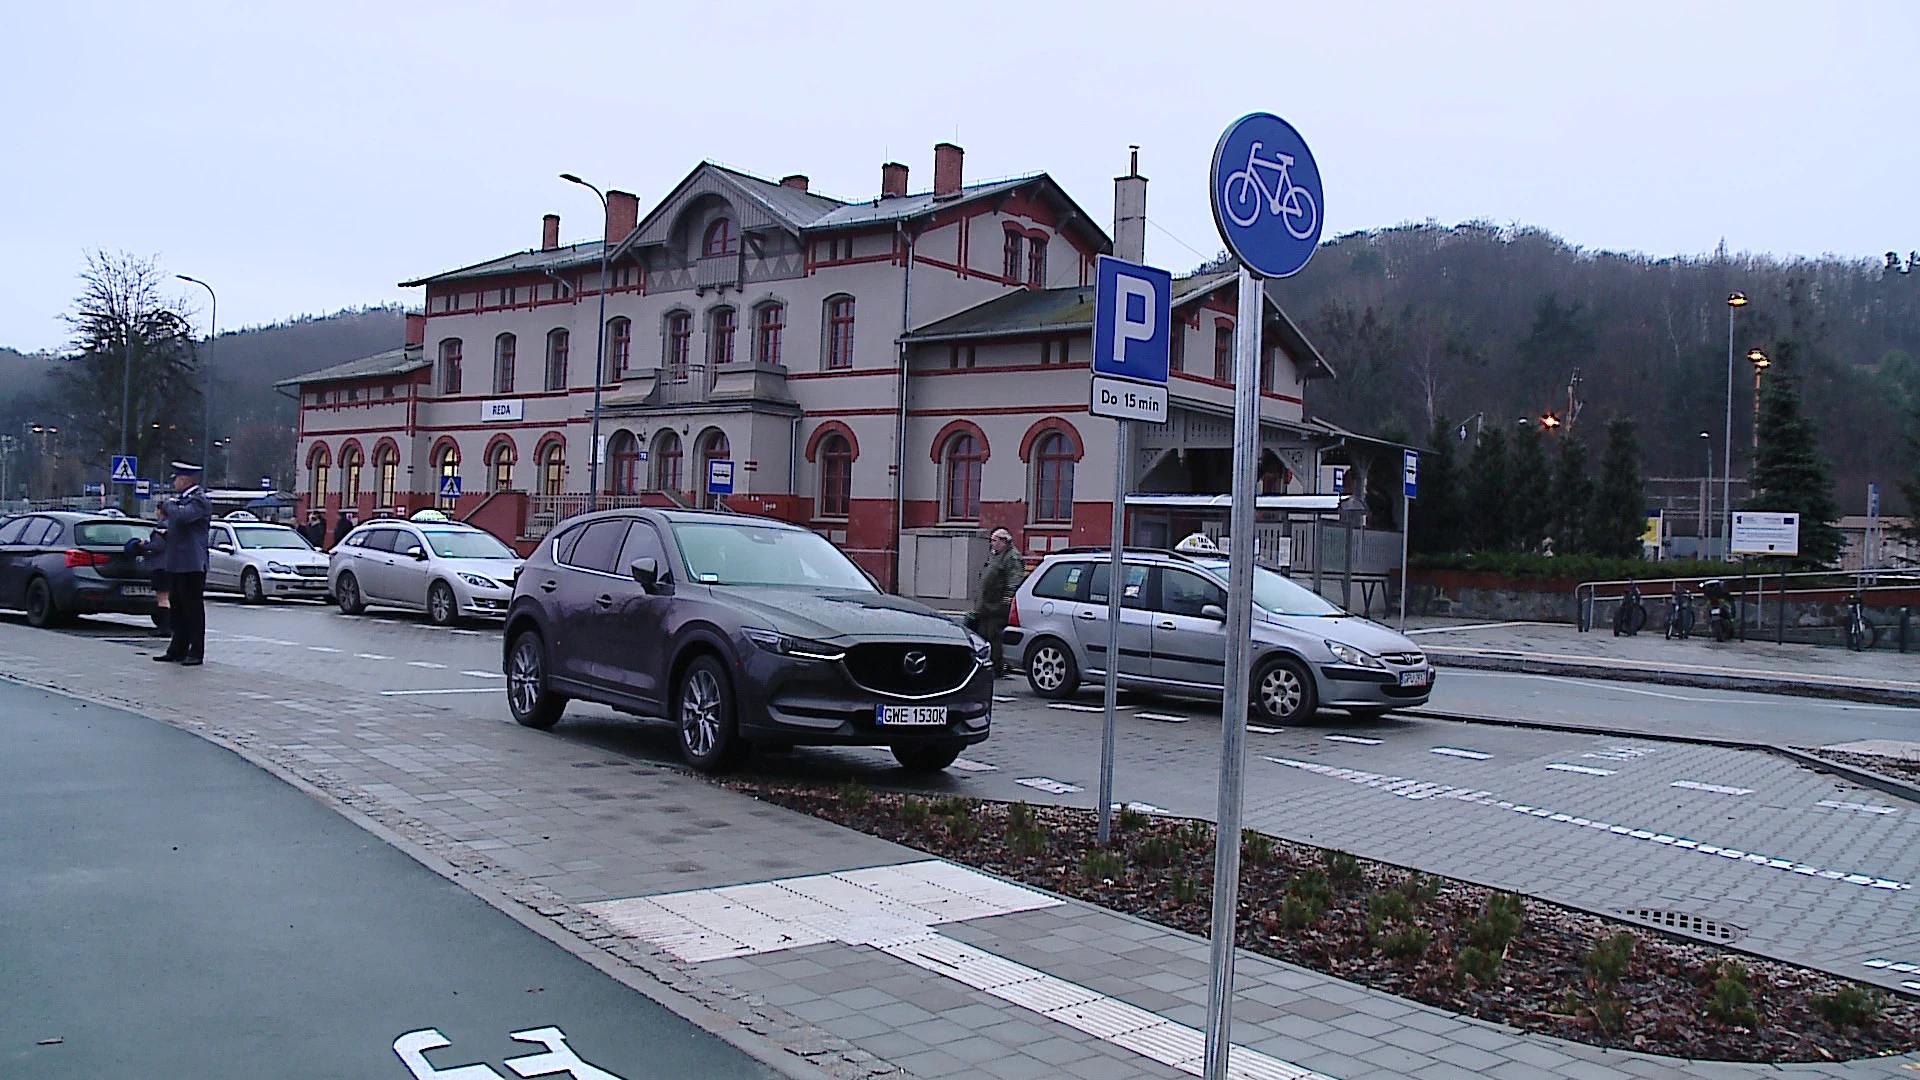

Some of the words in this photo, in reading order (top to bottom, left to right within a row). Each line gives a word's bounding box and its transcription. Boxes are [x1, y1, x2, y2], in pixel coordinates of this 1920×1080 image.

[1113, 273, 1156, 362] P
[1101, 389, 1118, 405] Do
[1124, 392, 1137, 408] 15
[1138, 396, 1159, 412] min
[492, 405, 511, 416] REDA
[884, 708, 909, 723] GWE
[913, 708, 945, 723] 1530K
